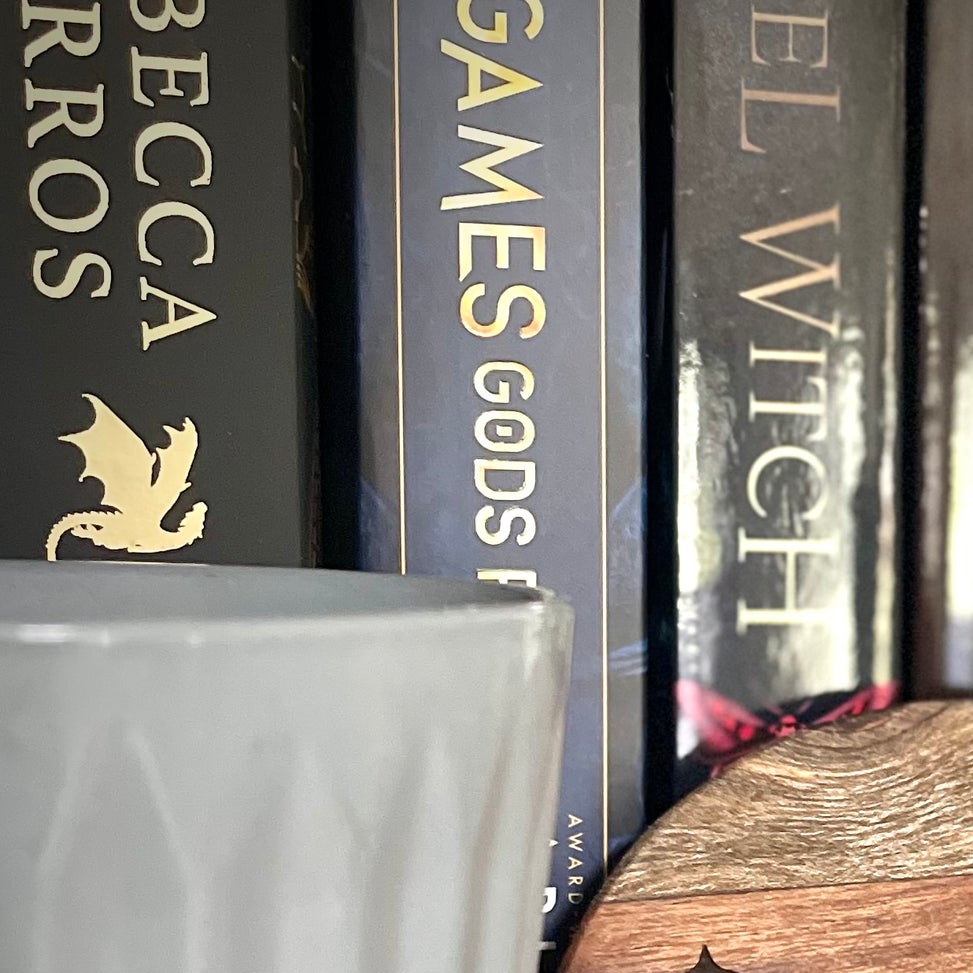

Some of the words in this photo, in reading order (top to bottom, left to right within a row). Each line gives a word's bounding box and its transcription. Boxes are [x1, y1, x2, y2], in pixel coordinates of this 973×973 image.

[20, 0, 113, 300] RROS
[130, 0, 218, 352] BECCA
[440, 0, 547, 339] GAMES
[740, 3, 841, 154] EL
[473, 361, 537, 546] GODS
[737, 203, 841, 634] WITCH
